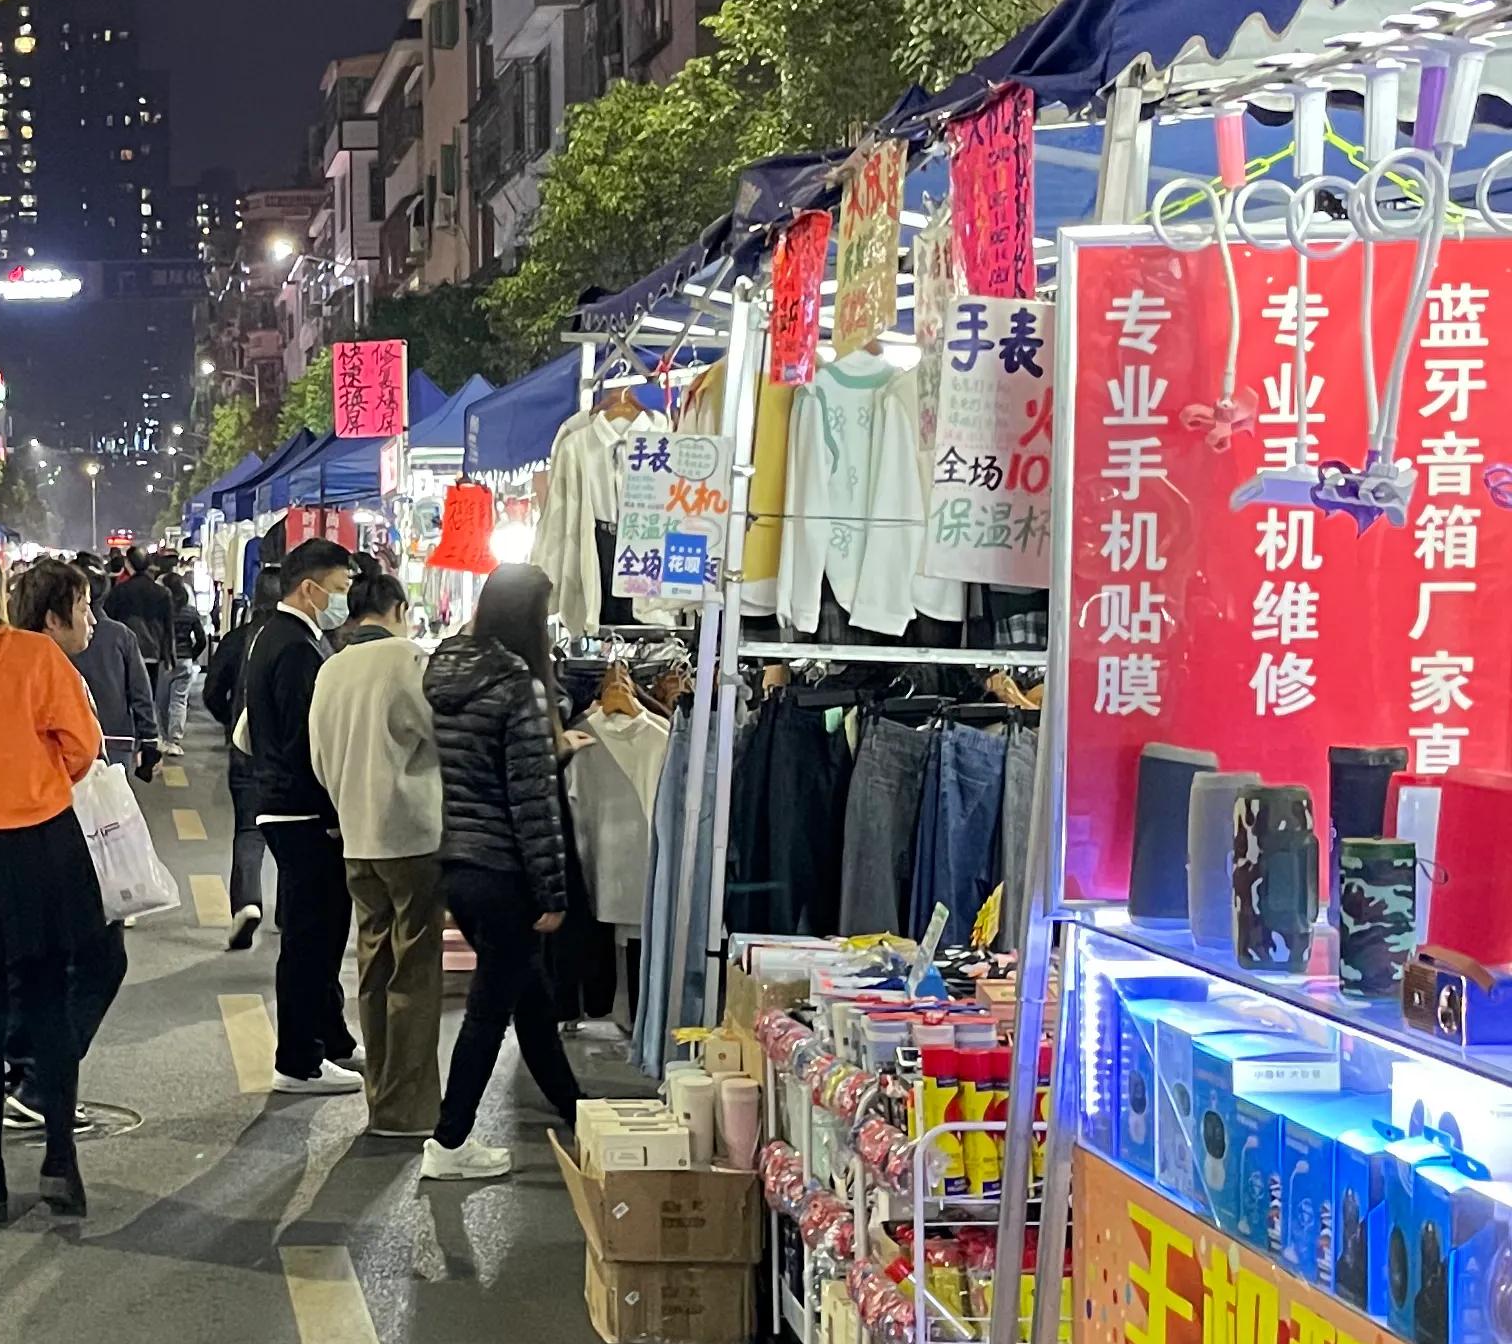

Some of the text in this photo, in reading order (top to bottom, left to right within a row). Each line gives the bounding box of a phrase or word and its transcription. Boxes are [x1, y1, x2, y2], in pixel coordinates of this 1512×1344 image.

[947, 302, 1044, 378] 手表
[627, 436, 672, 474] 手表
[665, 475, 729, 517] 火机
[930, 496, 1052, 558] 保温杯
[1093, 289, 1172, 717] 专业手机贴膜
[1408, 281, 1490, 775] 蓝牙音箱厂家直
[618, 544, 663, 581] 全场
